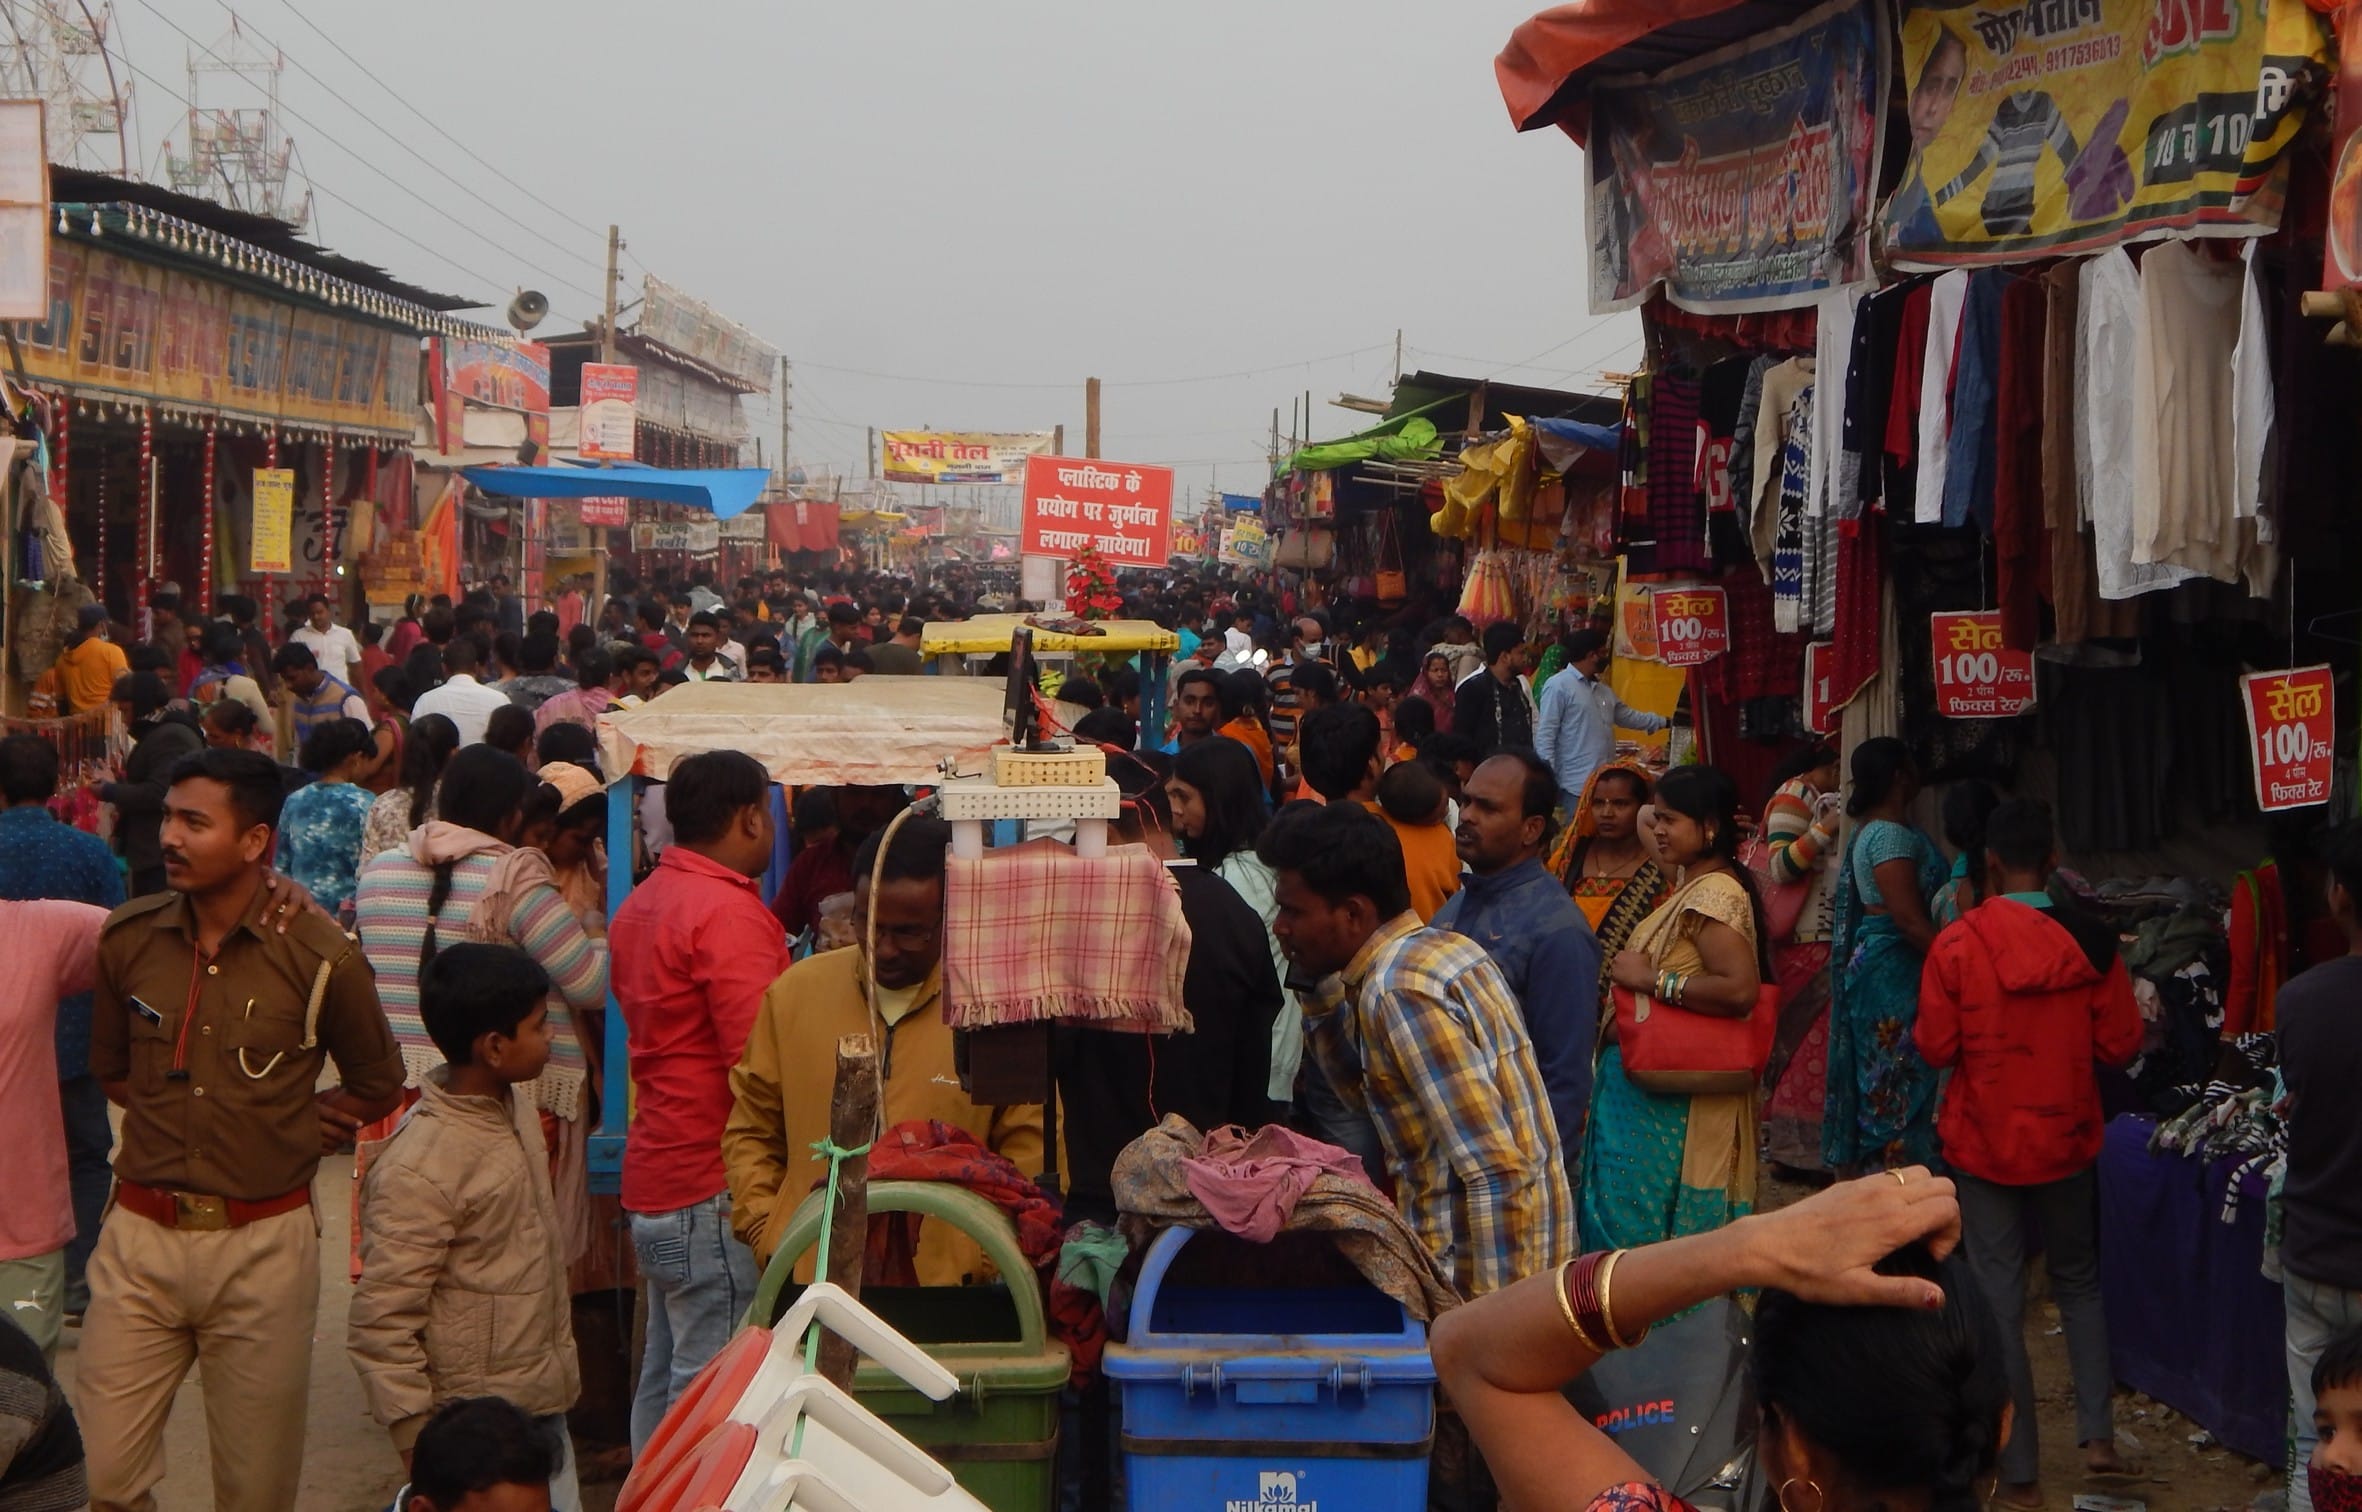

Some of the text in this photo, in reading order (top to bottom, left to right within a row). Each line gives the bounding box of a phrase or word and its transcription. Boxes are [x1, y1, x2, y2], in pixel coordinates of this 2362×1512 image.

[950, 440, 991, 461] तेल
[1057, 465, 1143, 493] प्लास्टिक के
[1036, 494, 1159, 529] प्रयोग पर जुर्माना
[1176, 534, 1196, 552] 10
[1236, 541, 1247, 553] 10
[1666, 594, 1717, 617] सेल
[1967, 687, 1974, 697] 2
[2266, 680, 2324, 721] सेल
[1949, 696, 2021, 712] फिक्स रेट
[2285, 768, 2291, 780] 4
[2271, 778, 2324, 803] फिक्स रेट
[1596, 1399, 1676, 1433] POLICE
